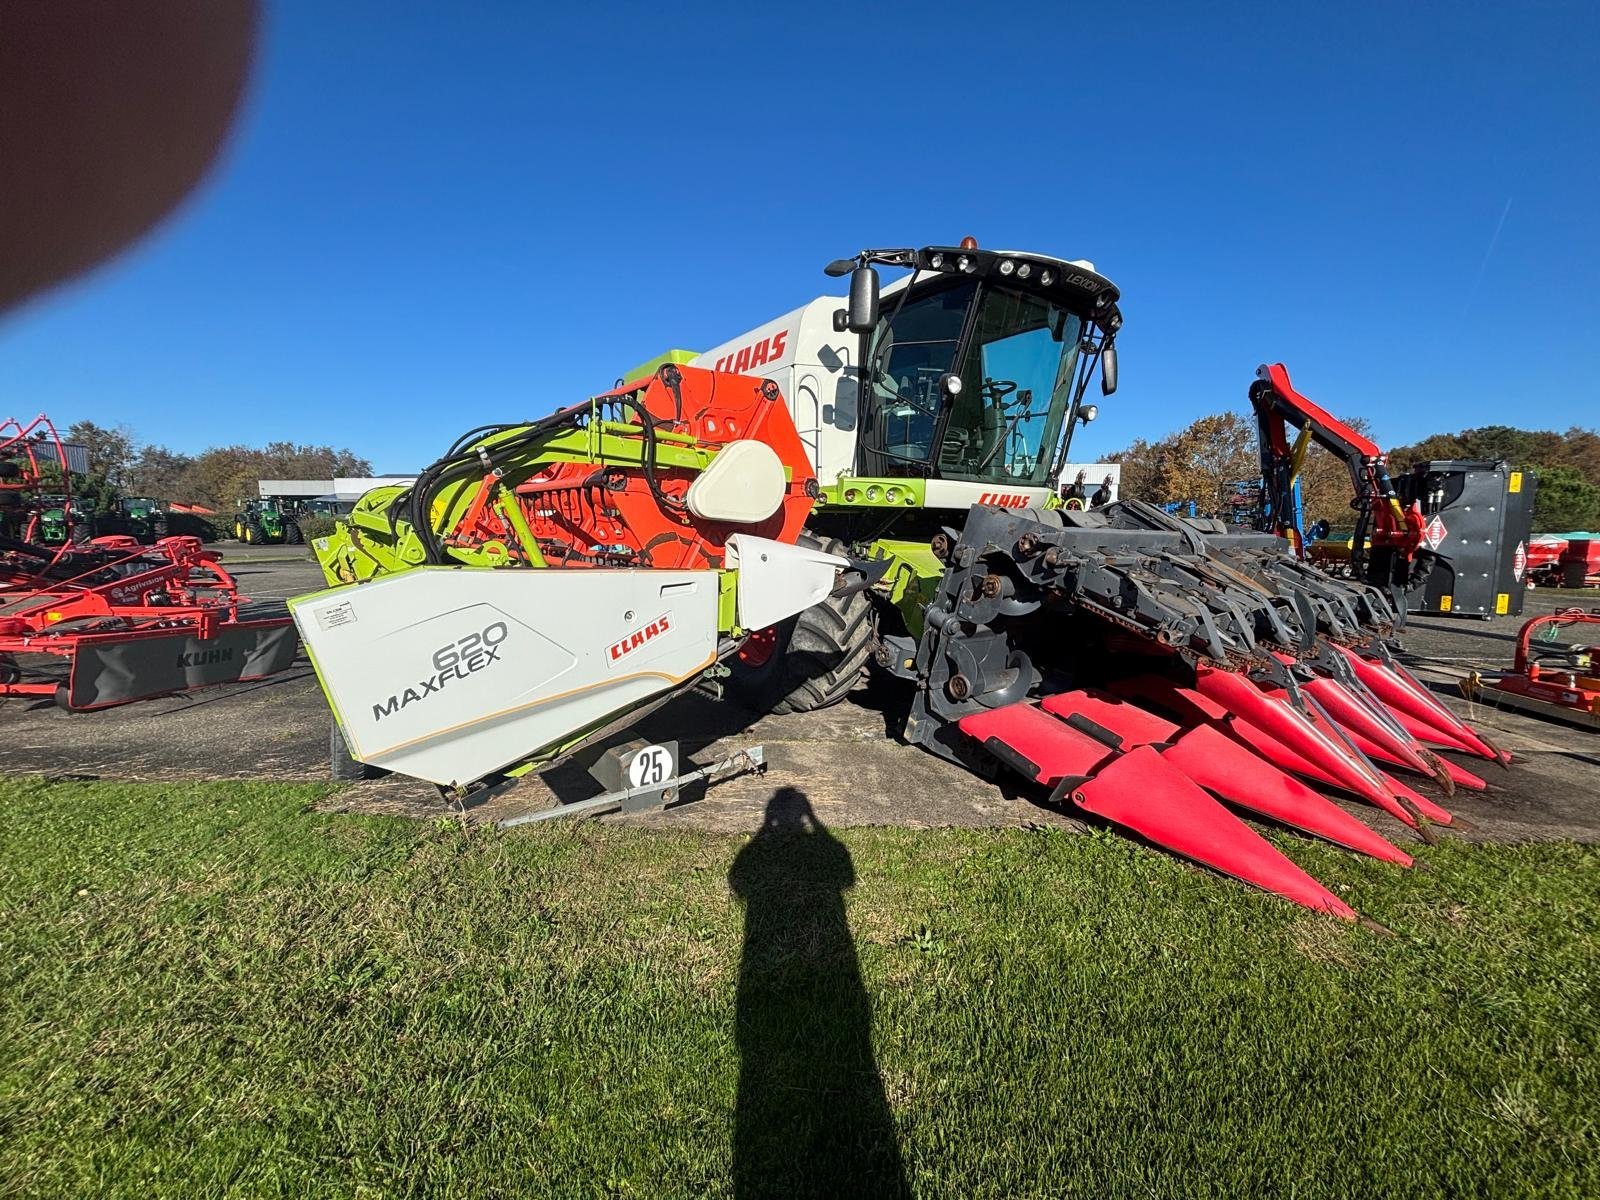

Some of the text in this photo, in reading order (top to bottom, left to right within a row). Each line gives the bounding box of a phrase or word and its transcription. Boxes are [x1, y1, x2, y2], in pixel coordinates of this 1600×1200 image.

[978, 493, 1031, 509] CLAAS
[1431, 521, 1441, 546] KUHN
[432, 621, 508, 671] 620
[610, 616, 669, 661] CLAAS
[176, 648, 233, 668] KUHN
[372, 645, 501, 722] MAXFLEX
[639, 749, 663, 786] 25
